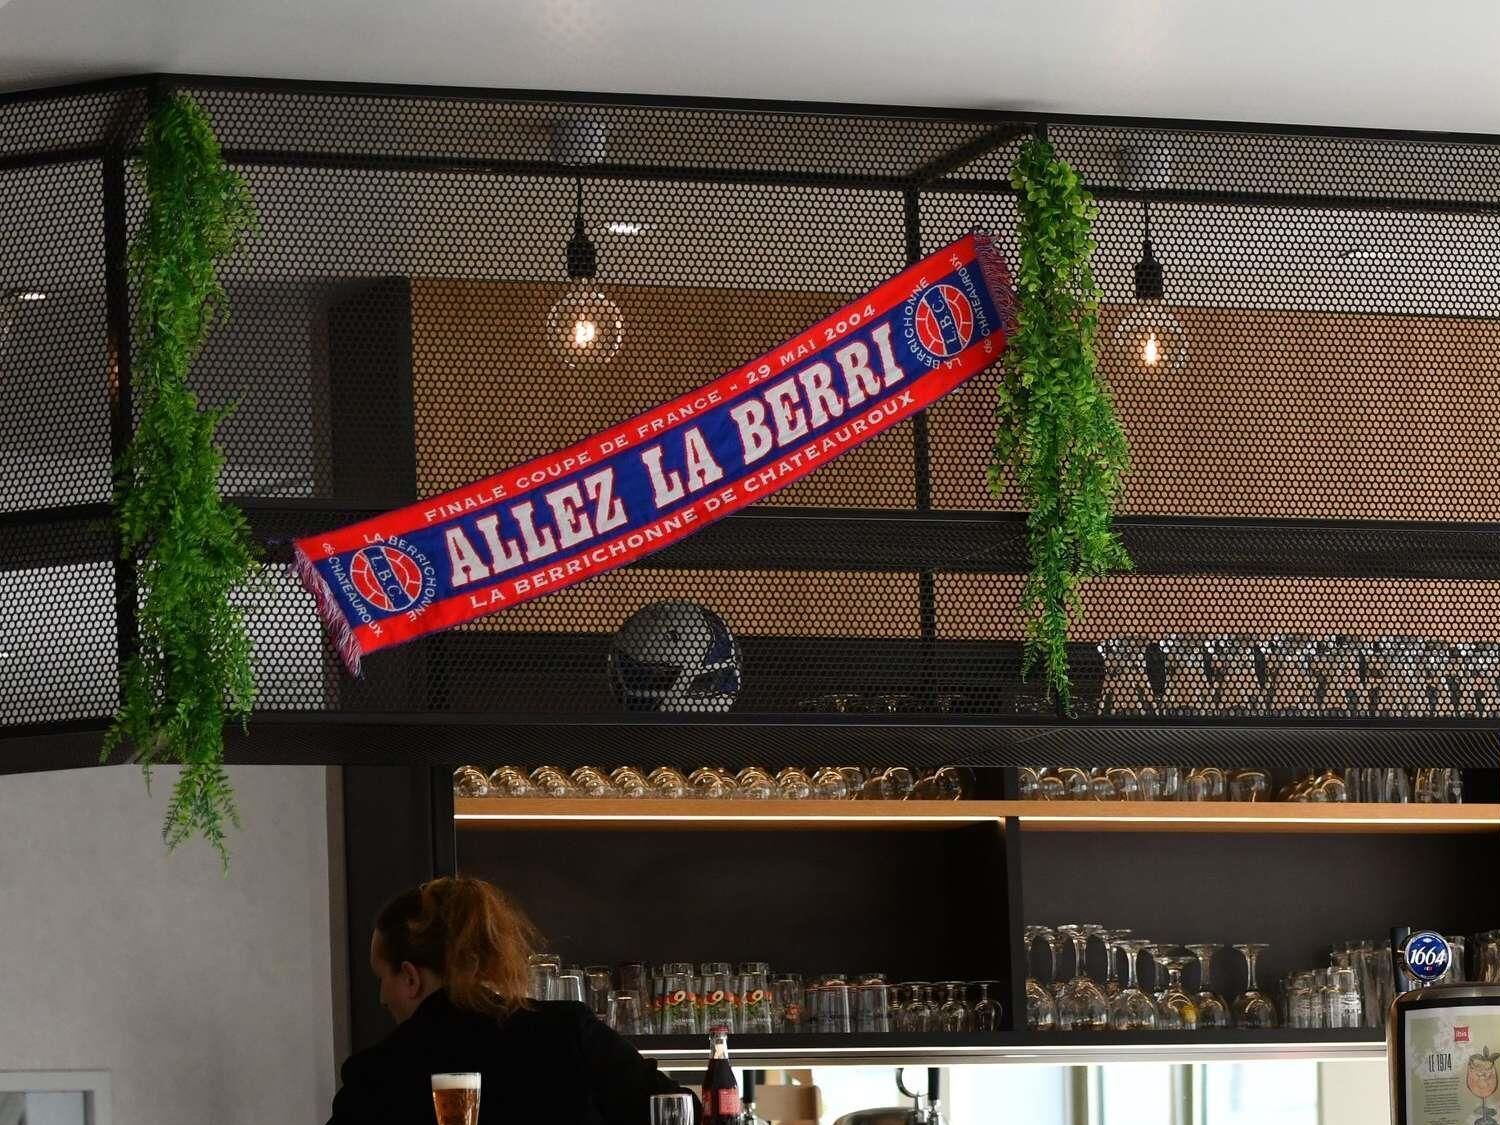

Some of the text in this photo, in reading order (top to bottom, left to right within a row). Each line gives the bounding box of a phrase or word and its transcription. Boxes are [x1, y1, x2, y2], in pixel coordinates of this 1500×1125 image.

[949, 253, 991, 337] CHATEAUROUX
[943, 357, 962, 370] LA
[424, 485, 507, 523] FINALE
[516, 450, 593, 488] COUPE
[600, 434, 630, 454] DE
[637, 390, 722, 438] FRANCE
[745, 364, 772, 385] 29
[778, 339, 817, 366] MAI
[823, 304, 876, 341] 2004
[444, 322, 904, 588] ALLEZ LA BERRI
[470, 390, 916, 609] LA BERRICHONNE DE CHATEAUROUX
[328, 556, 384, 638] CHATEAUROUX
[363, 533, 437, 622] LA BERRICHONNE
[1409, 945, 1447, 966] 1664
[1428, 1052, 1453, 1073] LE 1974
